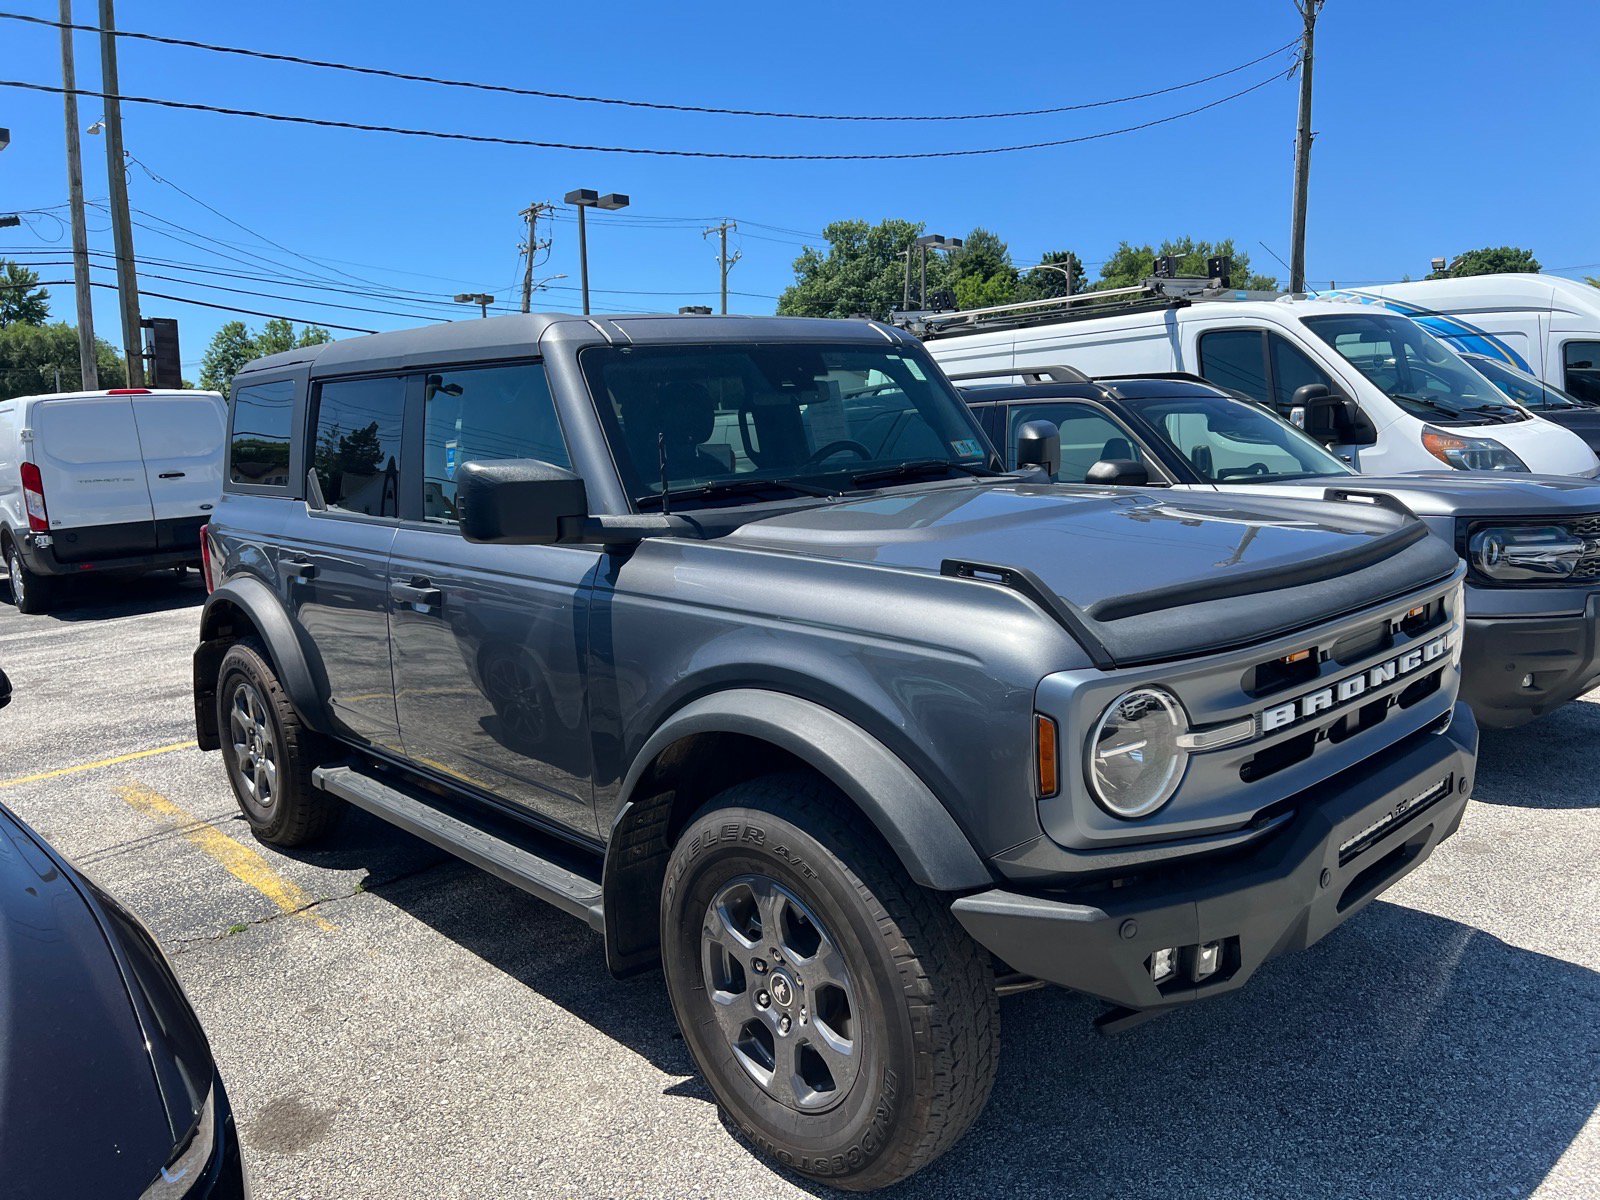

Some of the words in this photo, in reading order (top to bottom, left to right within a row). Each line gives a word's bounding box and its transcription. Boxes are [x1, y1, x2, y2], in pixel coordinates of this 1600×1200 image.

[1262, 638, 1443, 731] BRONCO
[665, 822, 766, 911] DUELER
[773, 844, 818, 880] A/T
